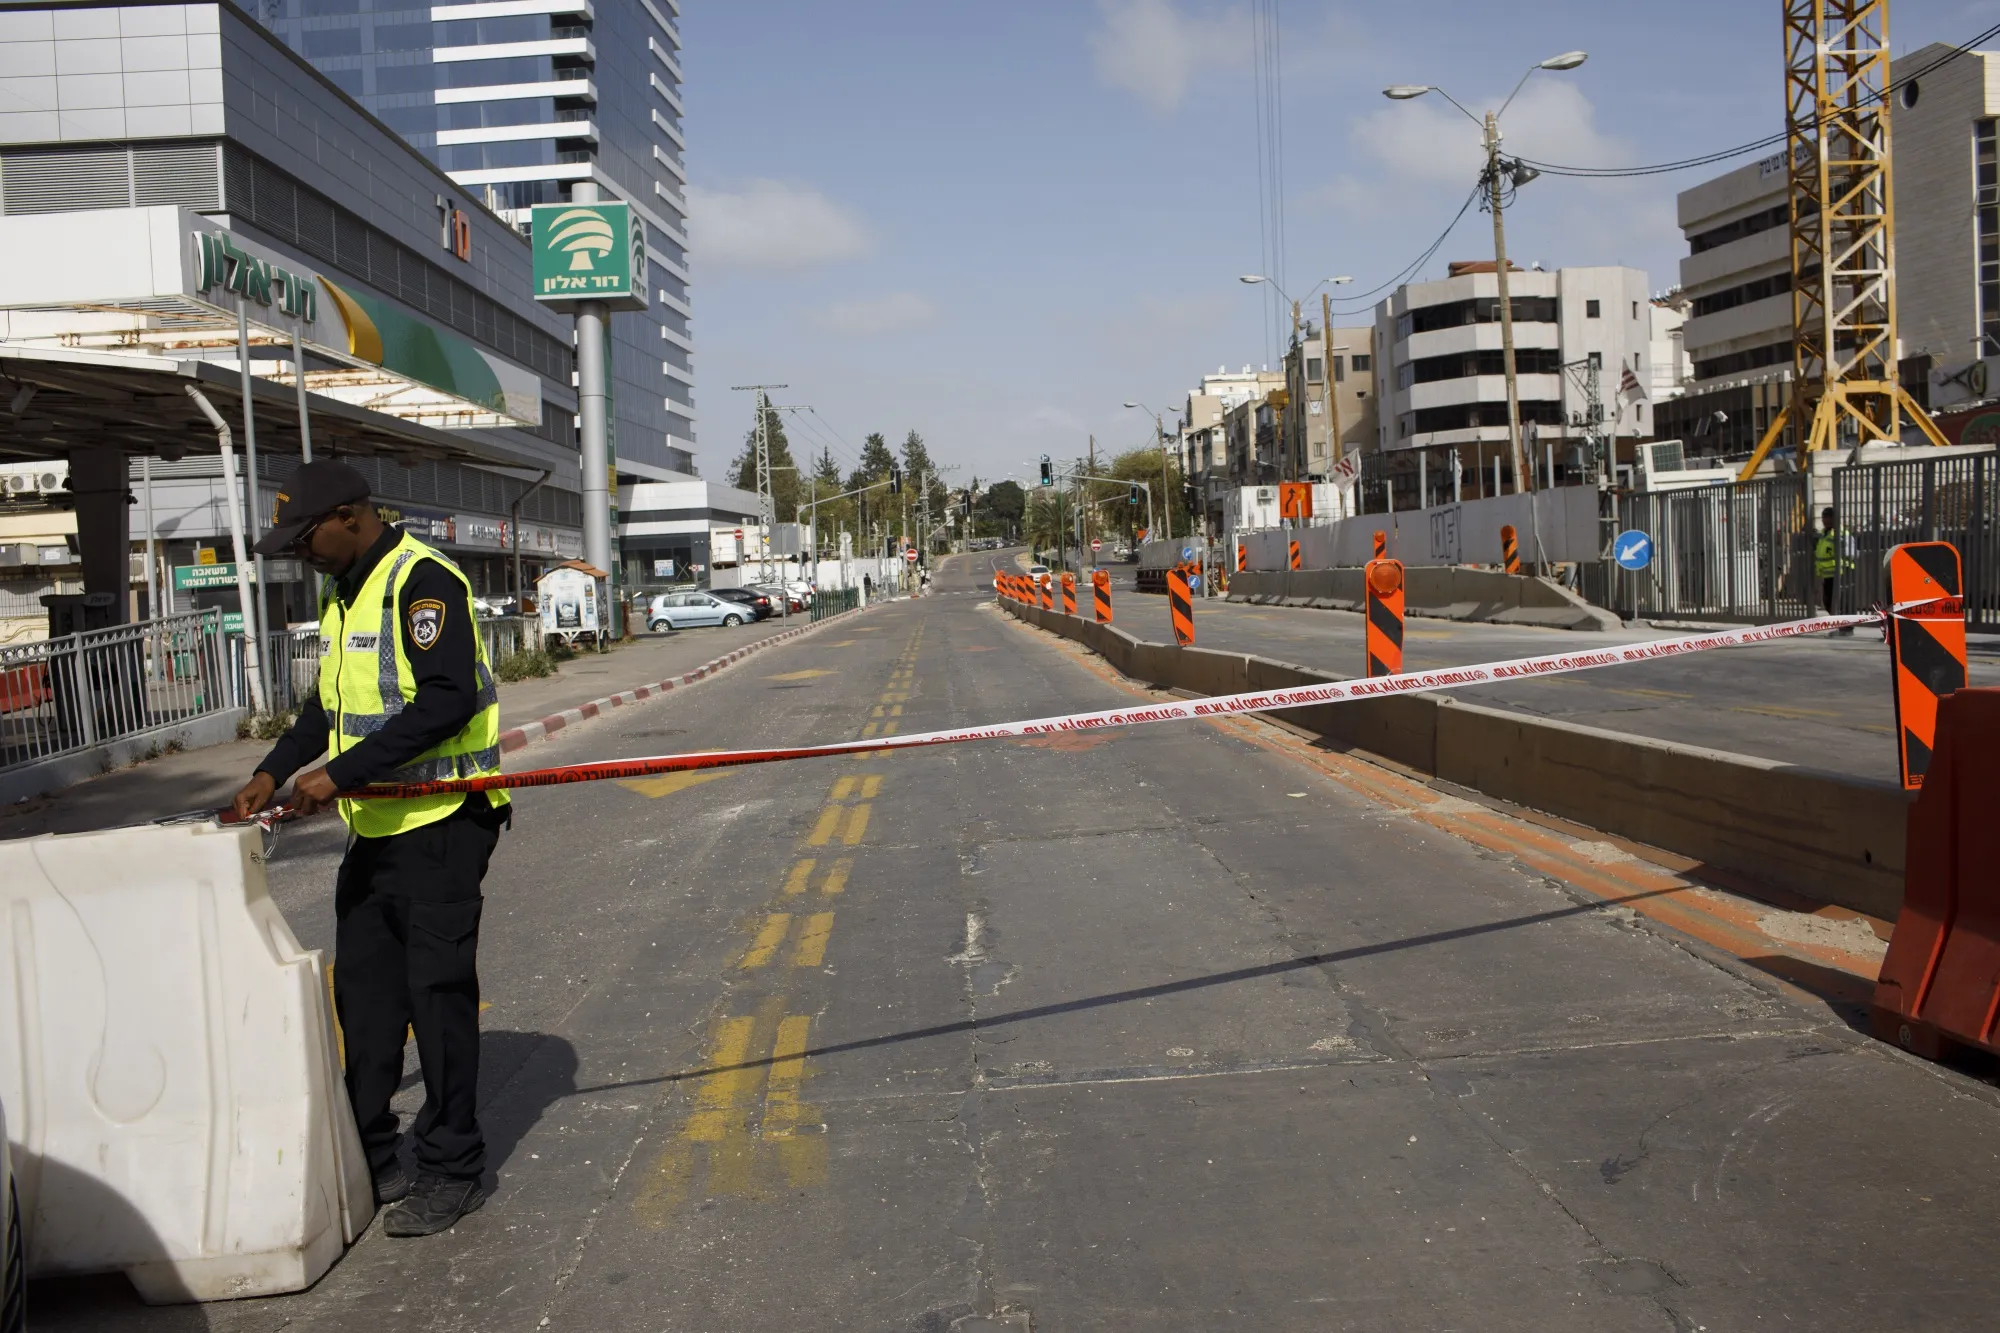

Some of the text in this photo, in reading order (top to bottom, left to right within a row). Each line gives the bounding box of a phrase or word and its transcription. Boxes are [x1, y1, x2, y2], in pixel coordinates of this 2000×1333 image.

[192, 230, 316, 323] דור אלון
[543, 275, 619, 292] דור אלון
[192, 566, 227, 577] משאבה
[348, 636, 377, 648] משטרה
[1571, 654, 1607, 668] משטרת
[1624, 649, 1648, 660] ישראל
[1647, 643, 1661, 656] אין
[1435, 660, 1559, 685] משטרת ישראל אין מעבר
[1288, 678, 1424, 704] משטרת ישראל אין מעבר
[1125, 697, 1277, 722] משטרת ישראל אין מעבר
[1075, 717, 1108, 728] מעבר
